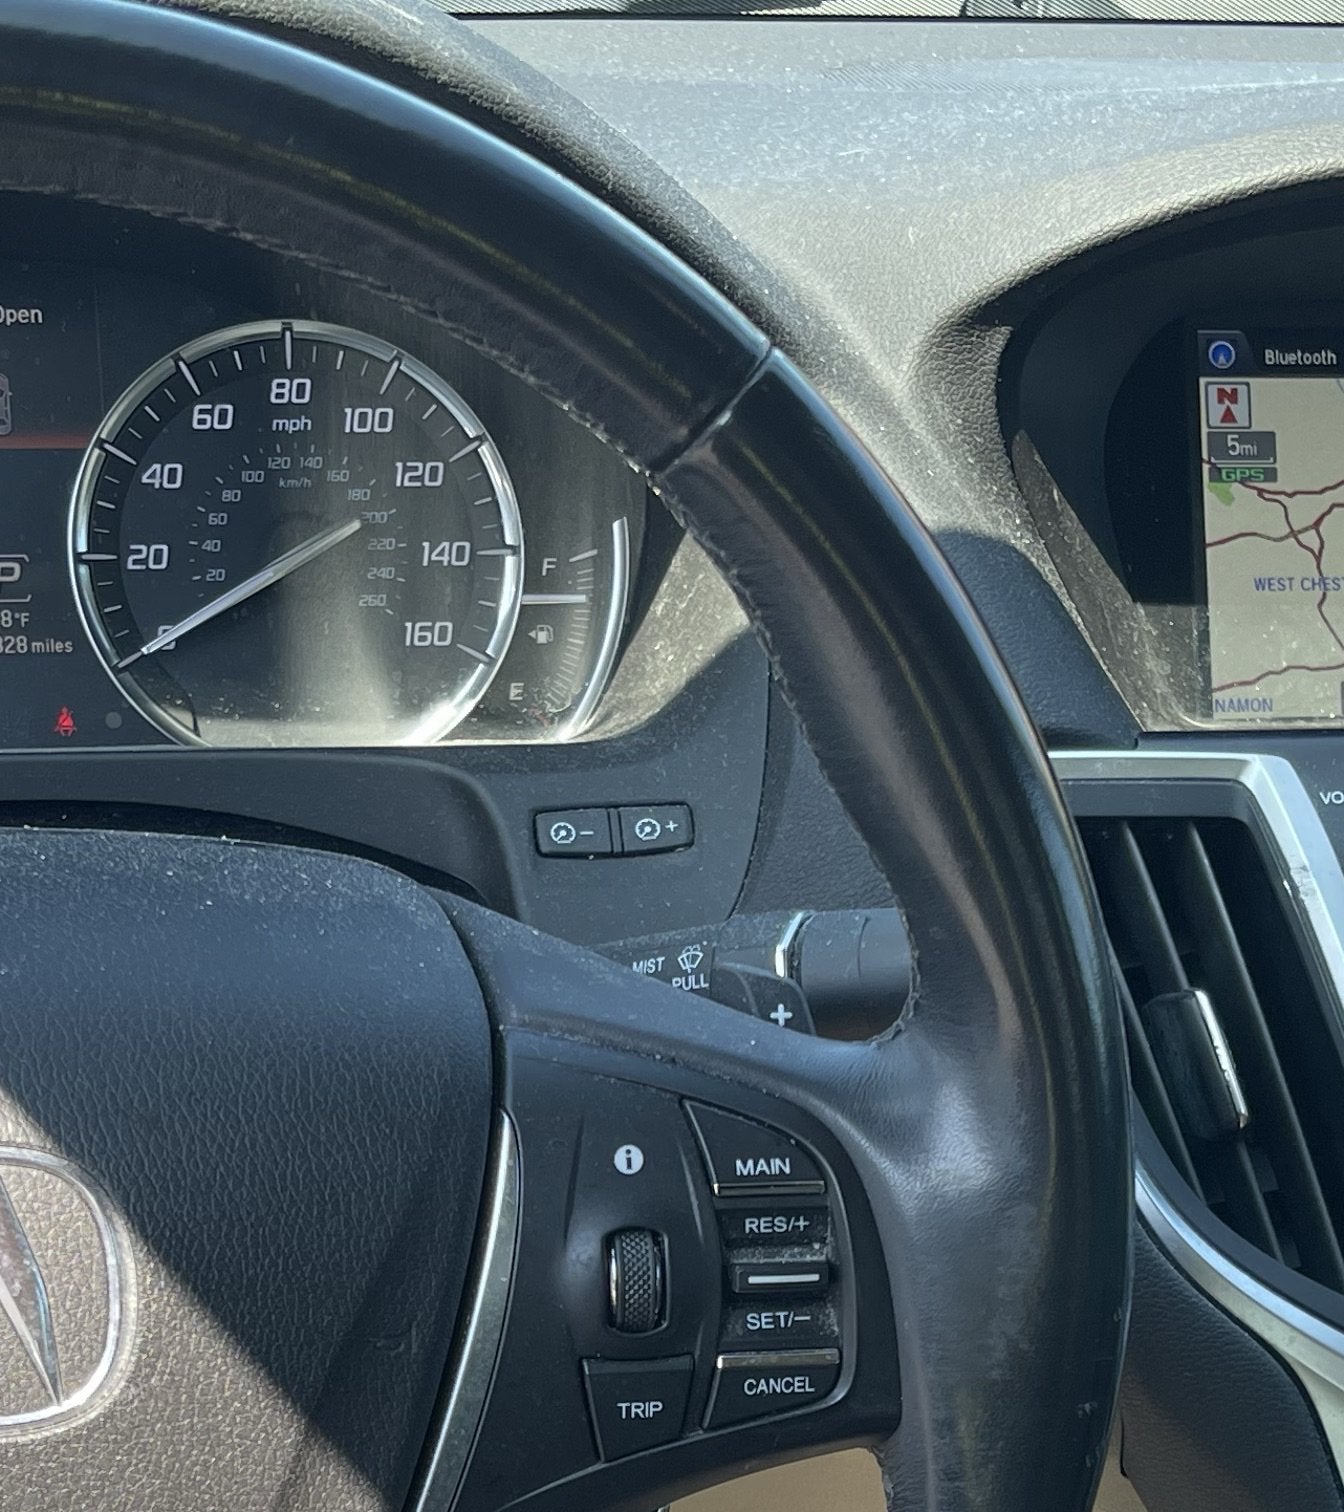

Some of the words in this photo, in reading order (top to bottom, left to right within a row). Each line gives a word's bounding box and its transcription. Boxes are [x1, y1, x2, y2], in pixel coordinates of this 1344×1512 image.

[1265, 349, 1337, 366] Bluetooth
[269, 378, 311, 404] 80
[192, 405, 234, 431] 60
[272, 416, 312, 434] mph
[343, 408, 393, 433] 100
[267, 455, 291, 469] 120
[299, 455, 323, 469] 140
[141, 464, 183, 490] 40
[241, 470, 265, 483] 100
[279, 475, 312, 490] km/h
[326, 470, 350, 483] 160
[394, 462, 444, 488] 120
[1221, 468, 1265, 481] GPS
[221, 489, 241, 503] 80
[347, 489, 371, 502] 180
[208, 513, 228, 527] 60
[201, 539, 221, 552] 40
[368, 538, 395, 552] 220
[127, 545, 169, 571] 20
[421, 542, 470, 568] 140
[205, 568, 226, 582] 20
[367, 566, 395, 580] 240
[542, 558, 557, 577] F
[1254, 577, 1297, 592] WEST
[359, 594, 387, 608] 260
[404, 622, 454, 648] 160
[31, 635, 73, 654] miles
[671, 973, 710, 992] PULL
[735, 1156, 791, 1177] MAIN
[743, 1376, 816, 1397] CANCEL
[617, 1401, 664, 1420] TRIP
